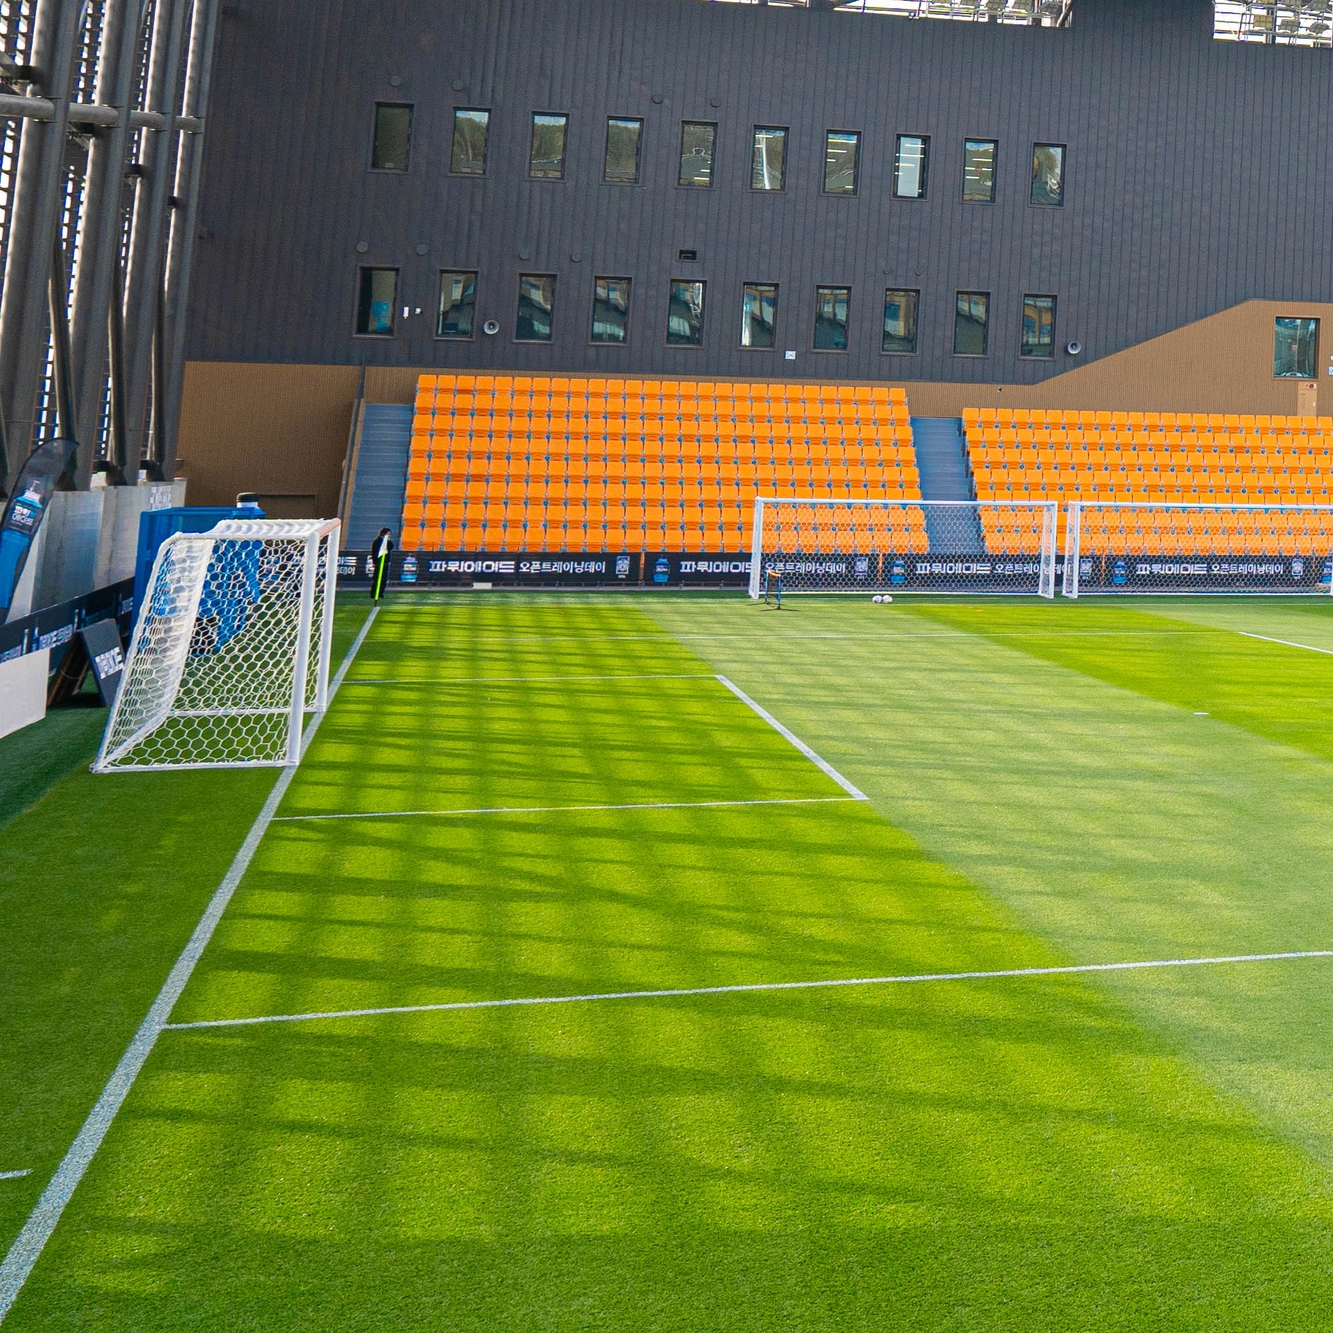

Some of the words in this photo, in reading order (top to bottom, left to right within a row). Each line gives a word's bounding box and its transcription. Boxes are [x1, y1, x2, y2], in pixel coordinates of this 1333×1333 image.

[428, 560, 515, 573] 파워에이드
[518, 561, 606, 574] 오픈트레이닝데이
[915, 563, 991, 574] 파워에이드
[1136, 563, 1208, 575] 파워에이드
